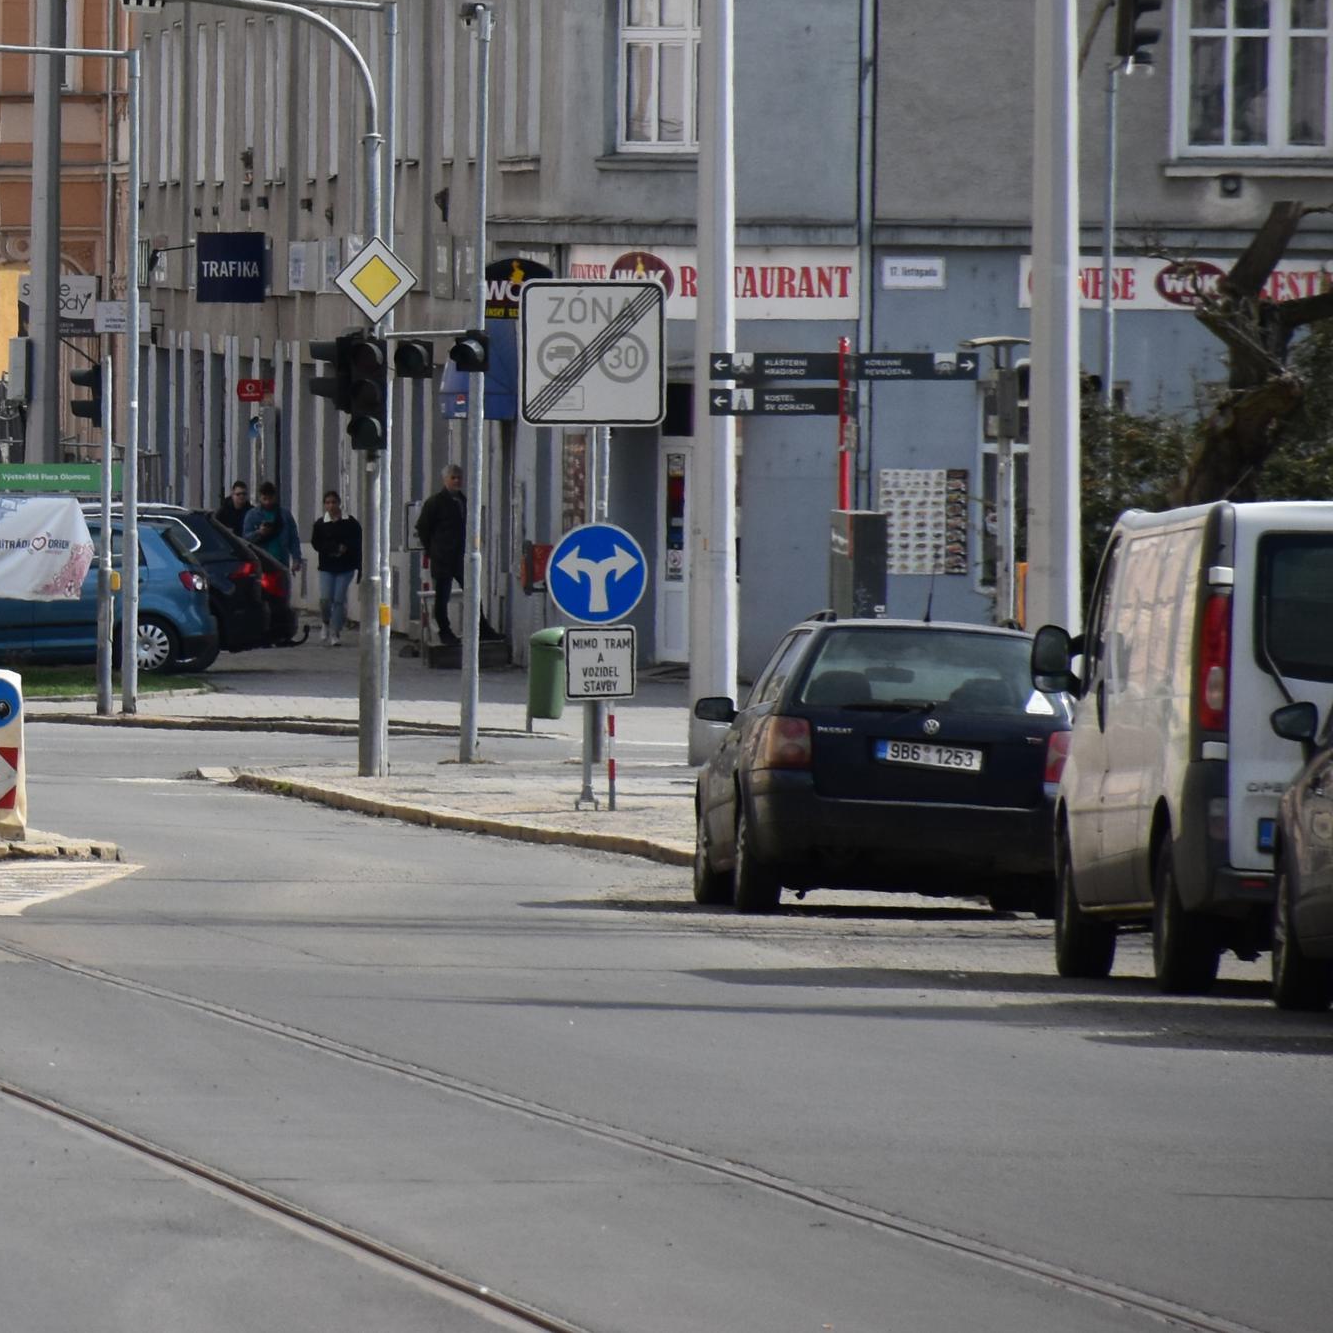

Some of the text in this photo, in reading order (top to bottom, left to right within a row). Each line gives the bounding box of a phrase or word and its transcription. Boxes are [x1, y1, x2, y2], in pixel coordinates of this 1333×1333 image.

[202, 260, 260, 278] TRAFIKA
[680, 266, 852, 299] RTAURANT
[608, 345, 639, 369] 30
[572, 637, 631, 649] MIMO TRAM
[597, 652, 604, 664] A
[582, 666, 620, 678] VOZIDEL
[583, 680, 618, 693] STAVBY
[890, 742, 975, 767] 9B6 1253
